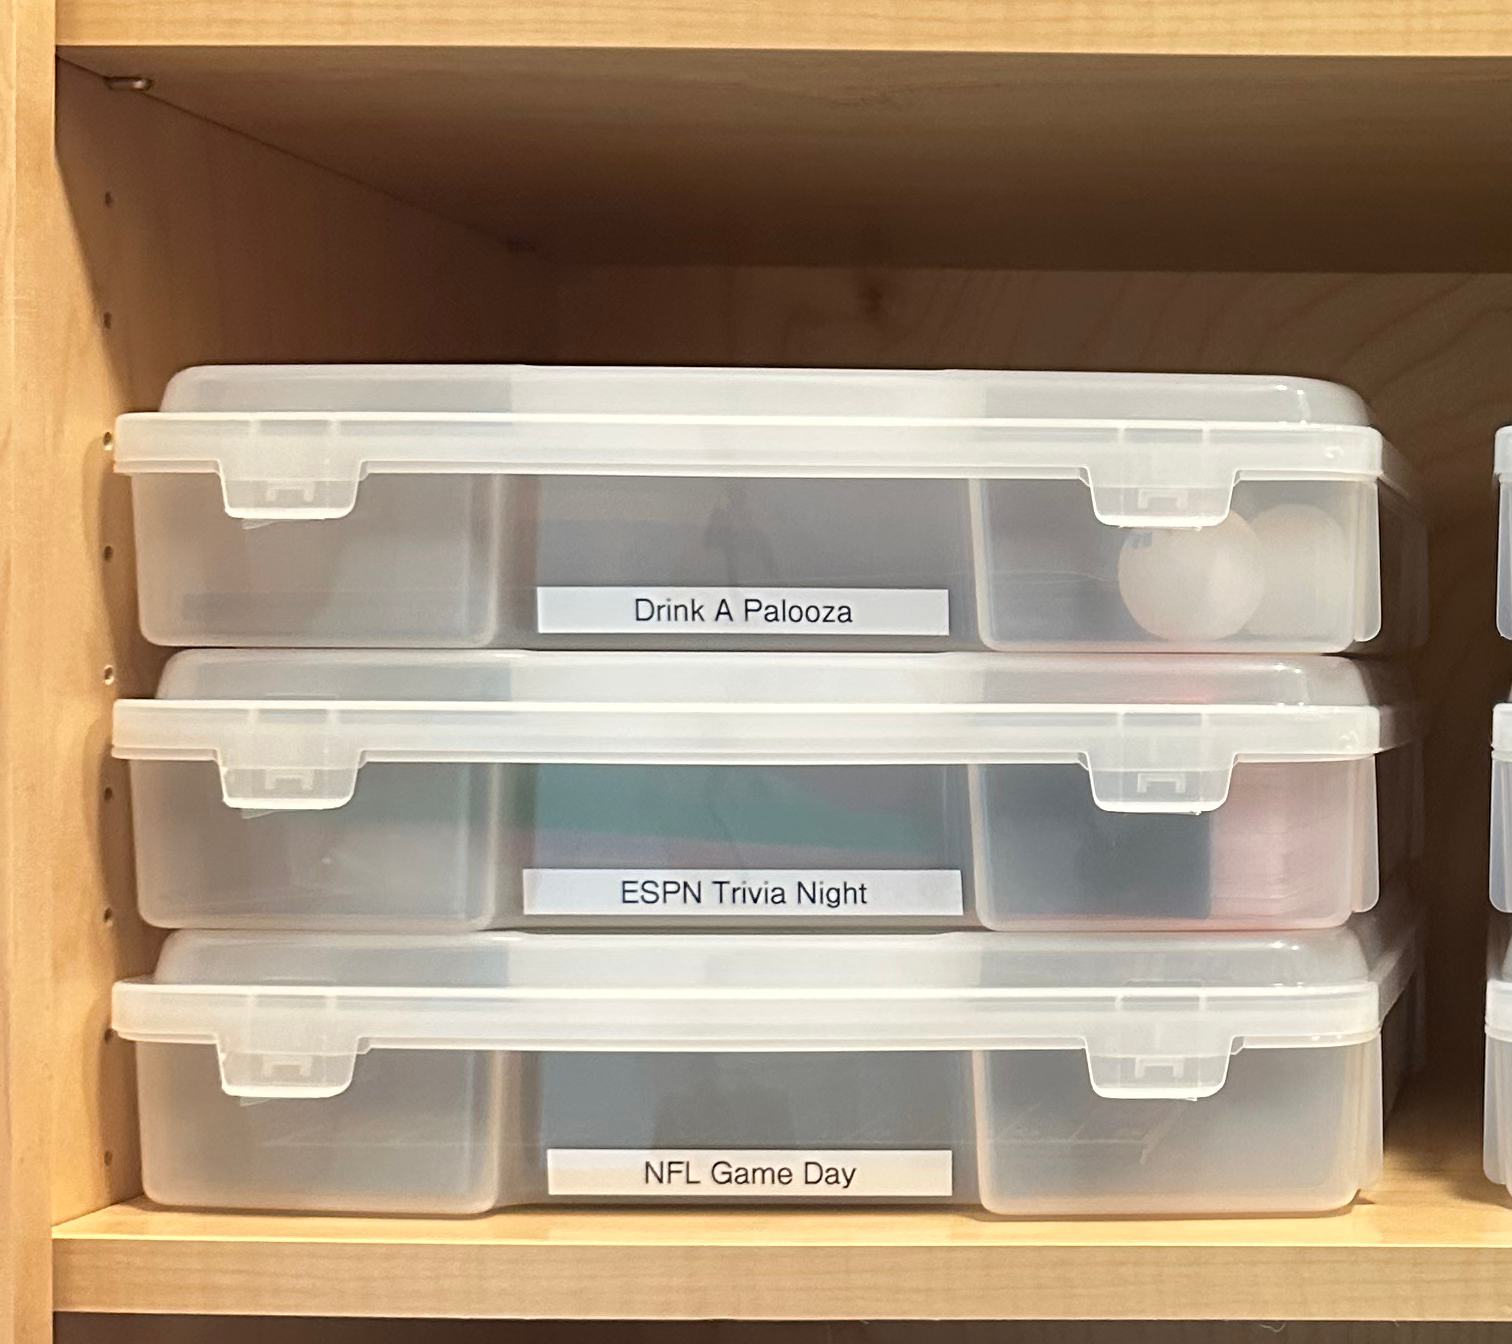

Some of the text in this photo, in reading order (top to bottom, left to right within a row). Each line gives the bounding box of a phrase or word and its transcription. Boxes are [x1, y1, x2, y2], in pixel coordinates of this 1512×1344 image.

[634, 597, 854, 625] Drink A Palooza
[620, 879, 869, 910] ESPN Trivia Night
[644, 1160, 857, 1190] NFL Game Day
